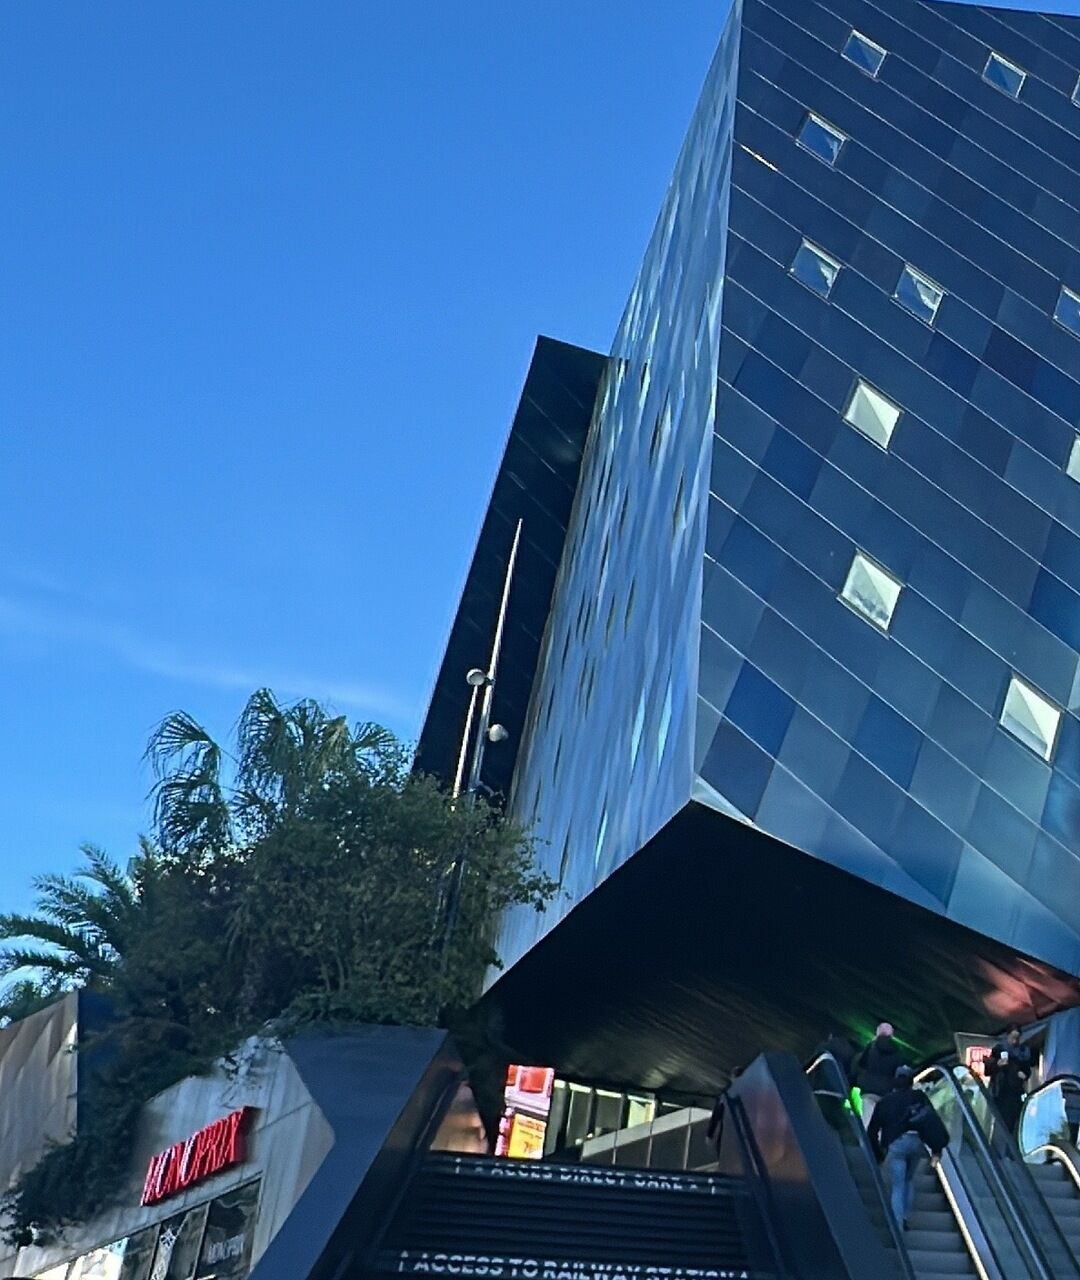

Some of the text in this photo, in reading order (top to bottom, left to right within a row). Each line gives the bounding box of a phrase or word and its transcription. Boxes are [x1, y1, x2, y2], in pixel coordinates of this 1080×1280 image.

[140, 1107, 246, 1207] MONOPRIX
[412, 1252, 504, 1276] ACCESS
[509, 1257, 539, 1277] TO
